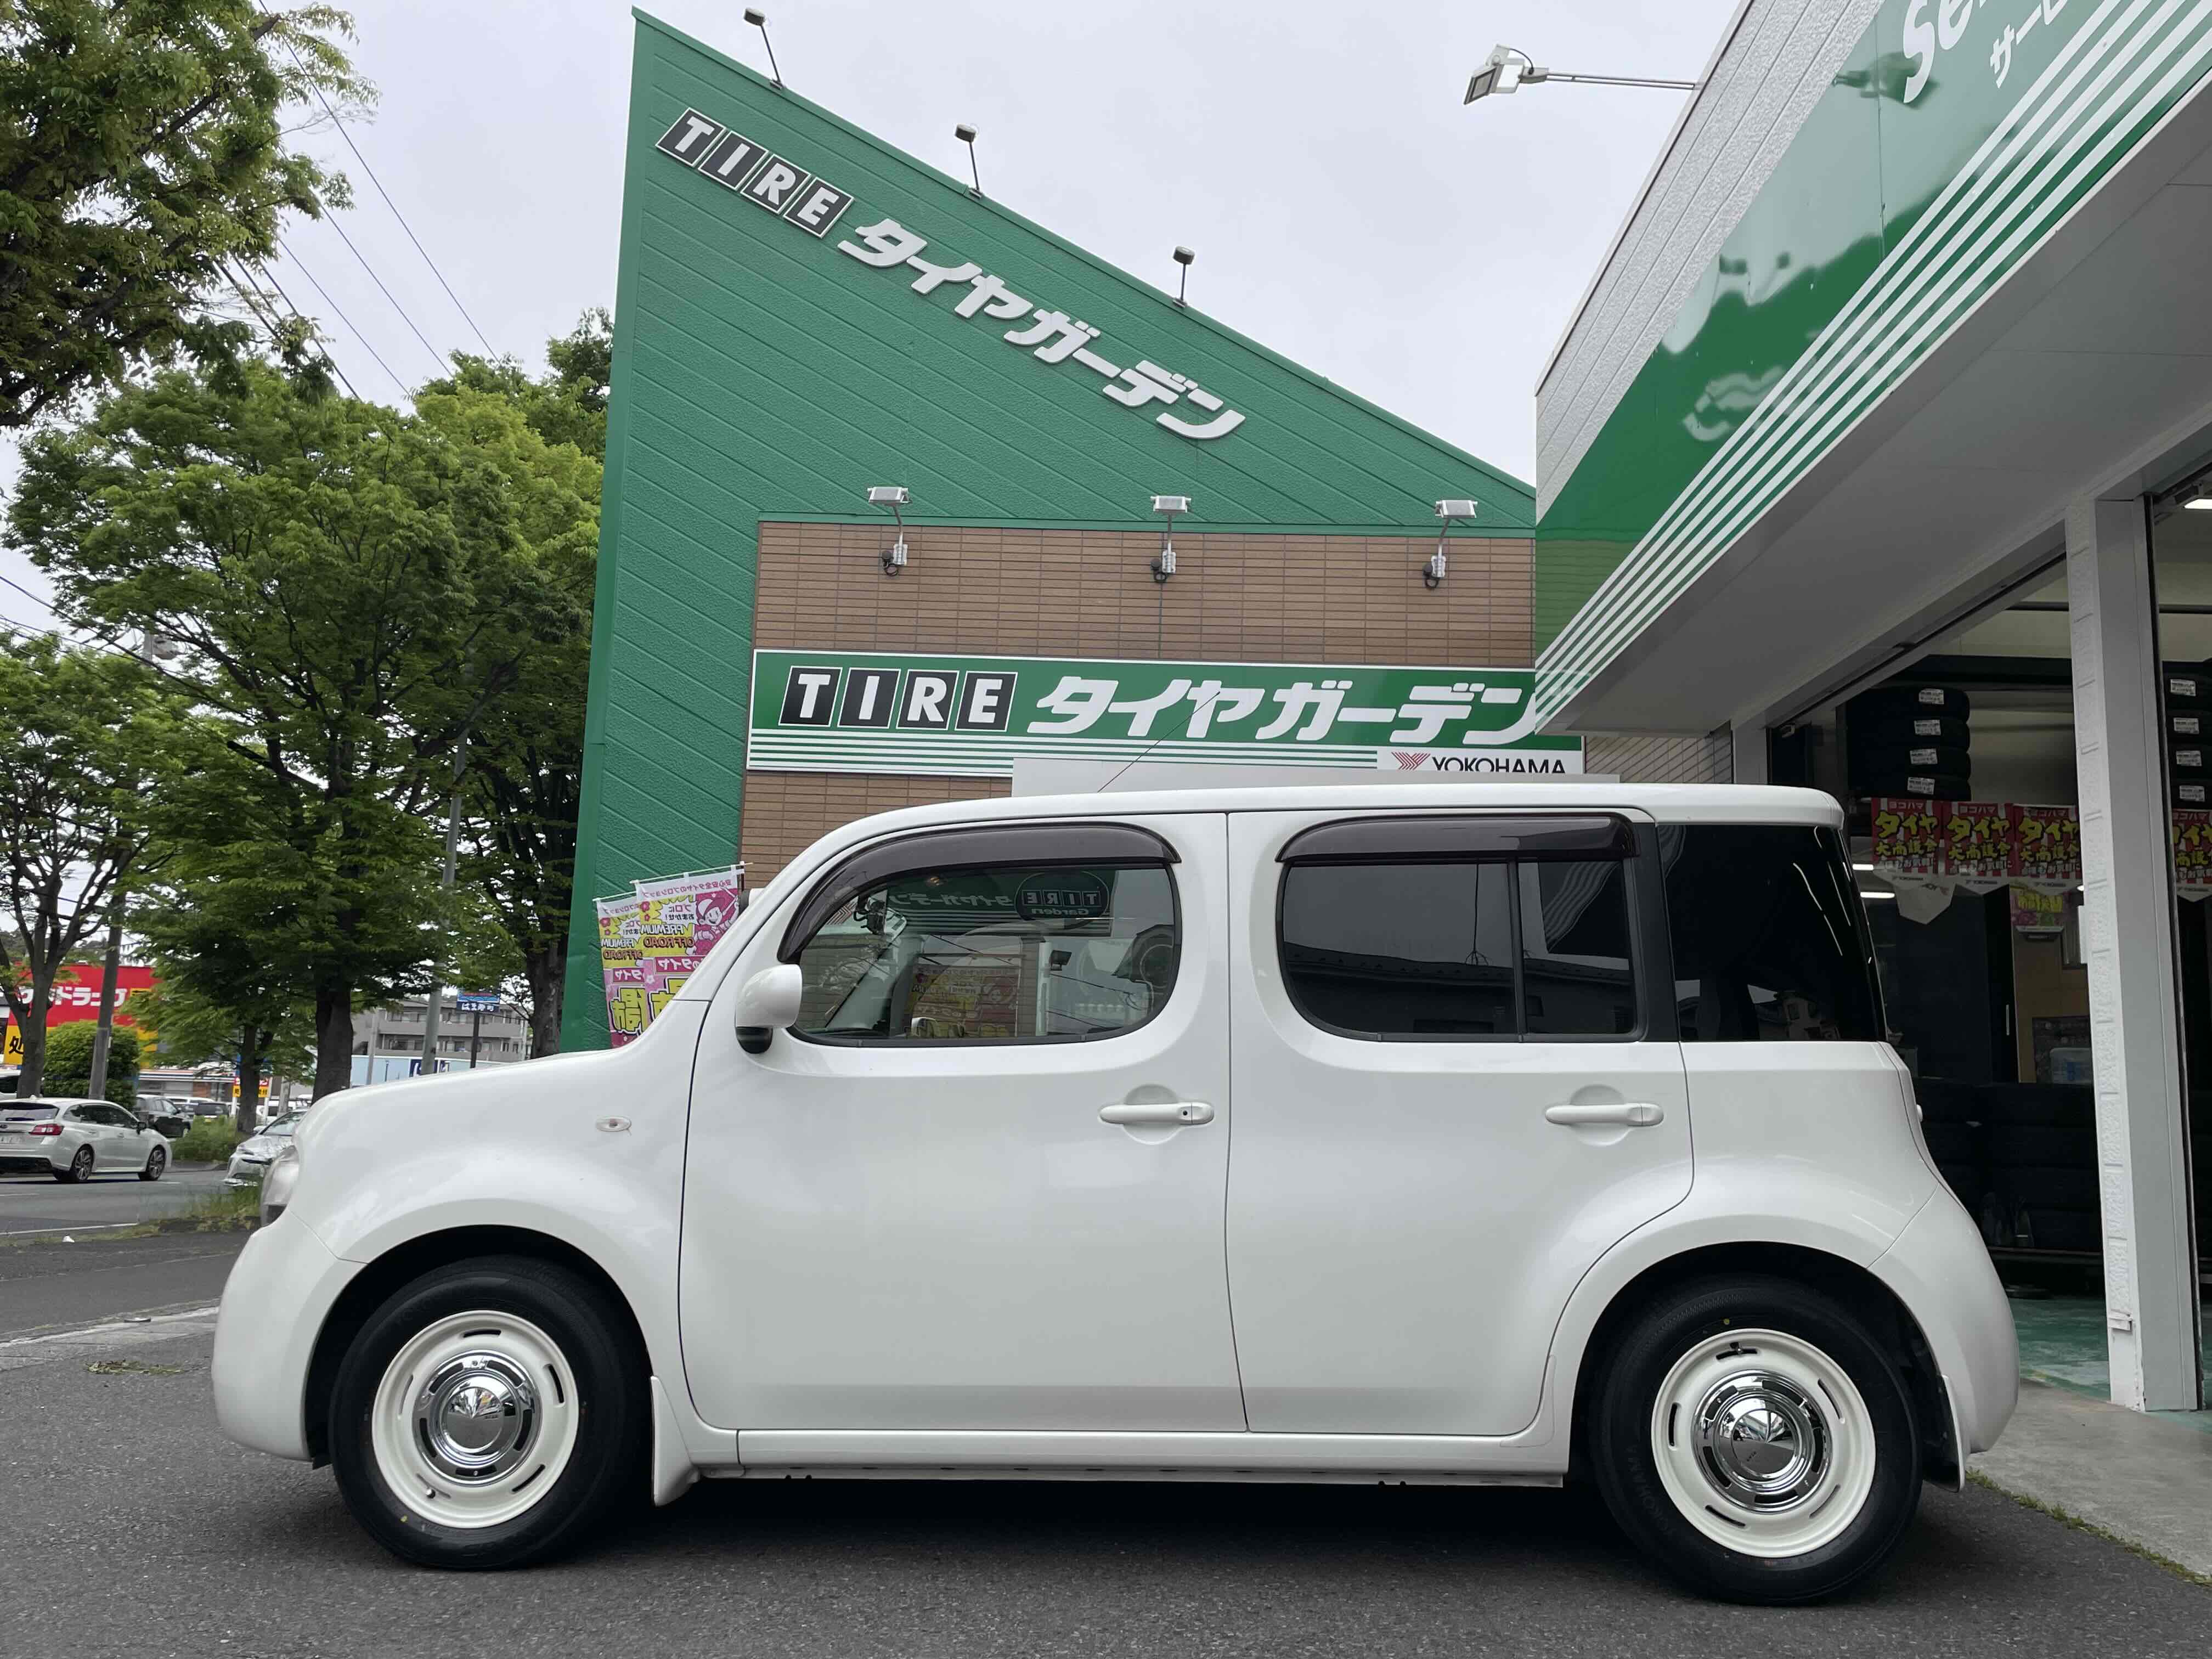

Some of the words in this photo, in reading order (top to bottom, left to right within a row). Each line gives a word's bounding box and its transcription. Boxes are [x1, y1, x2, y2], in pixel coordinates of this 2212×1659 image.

[1903, 0, 1986, 103] Se
[672, 114, 840, 226] TIRE
[837, 218, 1245, 439] タイヤガーデン
[797, 673, 1003, 724] TIRE
[1026, 675, 1537, 745] タイヤガーデン
[1432, 757, 1566, 774] YOKOHAMA
[1875, 811, 1939, 838] タイヤ
[1946, 815, 2010, 842] タイヤ
[2018, 817, 2079, 844] タイヤ
